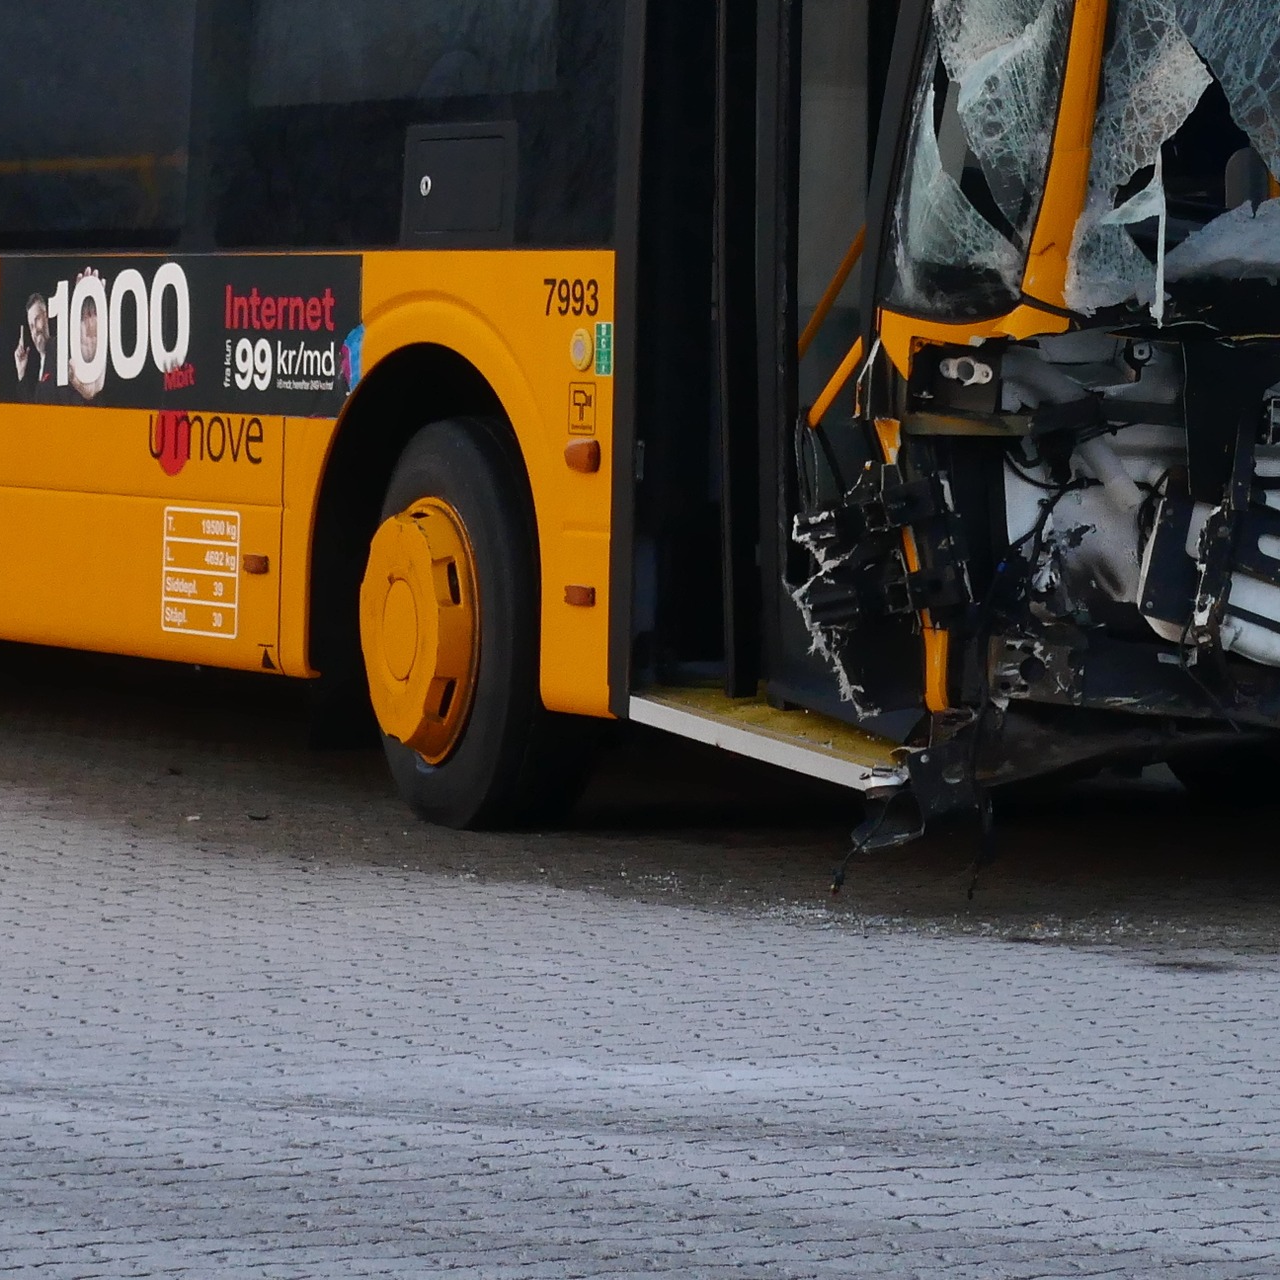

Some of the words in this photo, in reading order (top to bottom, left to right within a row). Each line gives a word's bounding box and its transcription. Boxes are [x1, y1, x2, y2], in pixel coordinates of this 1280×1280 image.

[224, 284, 336, 332] Internet
[543, 278, 599, 317] 7993
[47, 262, 190, 387] 1000
[224, 339, 232, 365] kun
[234, 338, 273, 391] 99
[276, 340, 336, 376] kr/md
[223, 368, 232, 388] fra
[201, 519, 225, 536] 19500
[226, 521, 238, 540] kg
[225, 552, 236, 571] kg
[212, 581, 224, 597] 39
